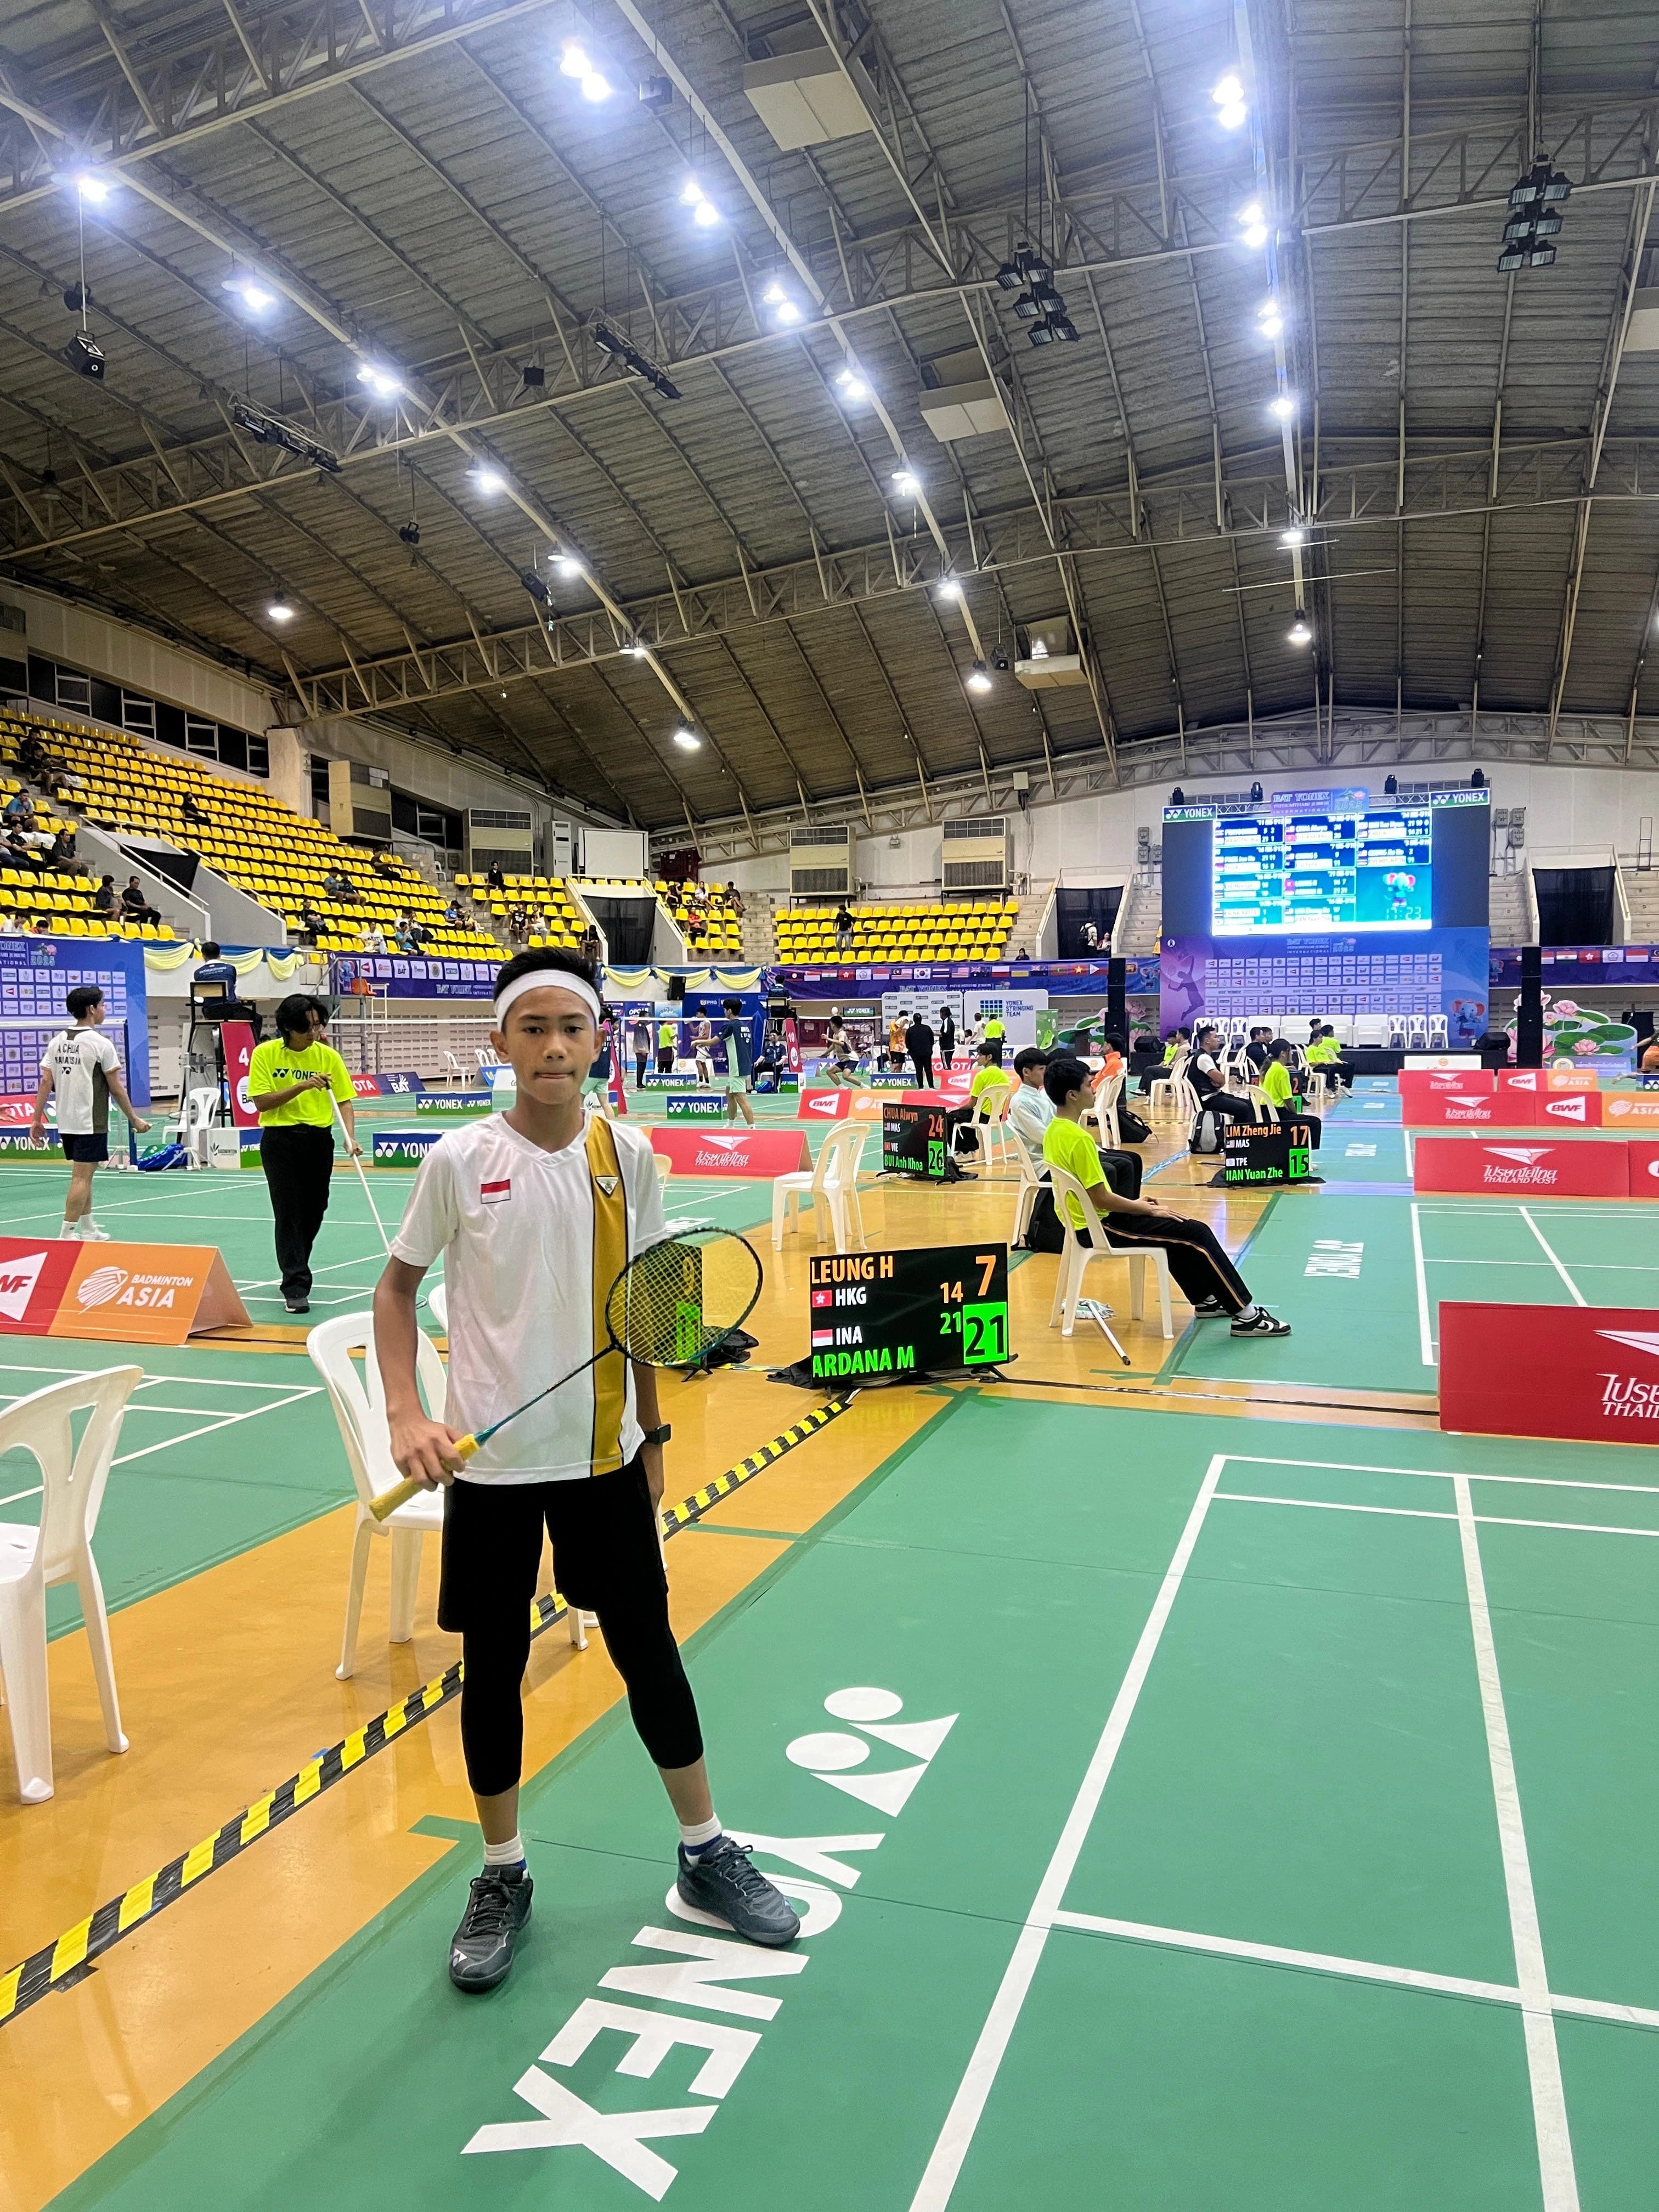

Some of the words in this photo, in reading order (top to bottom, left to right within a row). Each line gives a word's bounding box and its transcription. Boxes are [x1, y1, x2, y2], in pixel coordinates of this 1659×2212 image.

[1453, 792, 1485, 803] YONEX
[1184, 808, 1212, 818] YONEX
[1386, 906, 1422, 921] 17:23
[0, 941, 26, 951] ONEX
[31, 956, 55, 966] 2025
[788, 1032, 795, 1042] 10
[238, 1047, 249, 1066] 4
[353, 1079, 376, 1092] OTA
[391, 1081, 410, 1093] BAT
[661, 1079, 684, 1087] YONEX
[887, 1079, 911, 1087] YONEX
[1293, 1077, 1299, 1093] 2
[435, 1099, 462, 1109] YONEX
[476, 1098, 491, 1107] YONEX
[687, 1102, 719, 1113] YONEX
[884, 1107, 899, 1120] CHUA
[900, 1108, 918, 1123] Alwyn
[890, 1122, 900, 1132] MAS
[928, 1114, 944, 1137] 24
[1226, 1125, 1240, 1137] LIM
[1242, 1125, 1268, 1137] Zheng
[1269, 1124, 1281, 1135] Jie
[1235, 1139, 1250, 1148] MAS
[1290, 1125, 1309, 1146] 17
[401, 1142, 436, 1158] YON
[884, 1154, 894, 1166] BUI
[895, 1156, 907, 1169] Anh
[908, 1157, 923, 1171] Khoa
[929, 1147, 944, 1171] 26
[1235, 1157, 1248, 1166] TPE
[1290, 1154, 1309, 1175] 15
[1245, 1169, 1266, 1180] Yuan
[1268, 1167, 1283, 1178] Zhe
[811, 1257, 874, 1284] LEUNG
[880, 1255, 893, 1279] H
[1304, 1253, 1363, 1279] YONEX
[0, 1274, 32, 1293] WF
[131, 1274, 194, 1286] BADMINTON
[975, 1255, 996, 1296] 7
[116, 1286, 176, 1308] ASIA
[836, 1286, 867, 1307] HKG
[940, 1281, 963, 1304] 14
[940, 1311, 961, 1334] 21
[836, 1326, 863, 1346] INA
[964, 1314, 1006, 1358] 21
[812, 1347, 892, 1378] ARDANA
[897, 1345, 915, 1369] M
[1602, 1401, 1659, 1419] THAIL
[460, 1830, 886, 2202] YONEX
